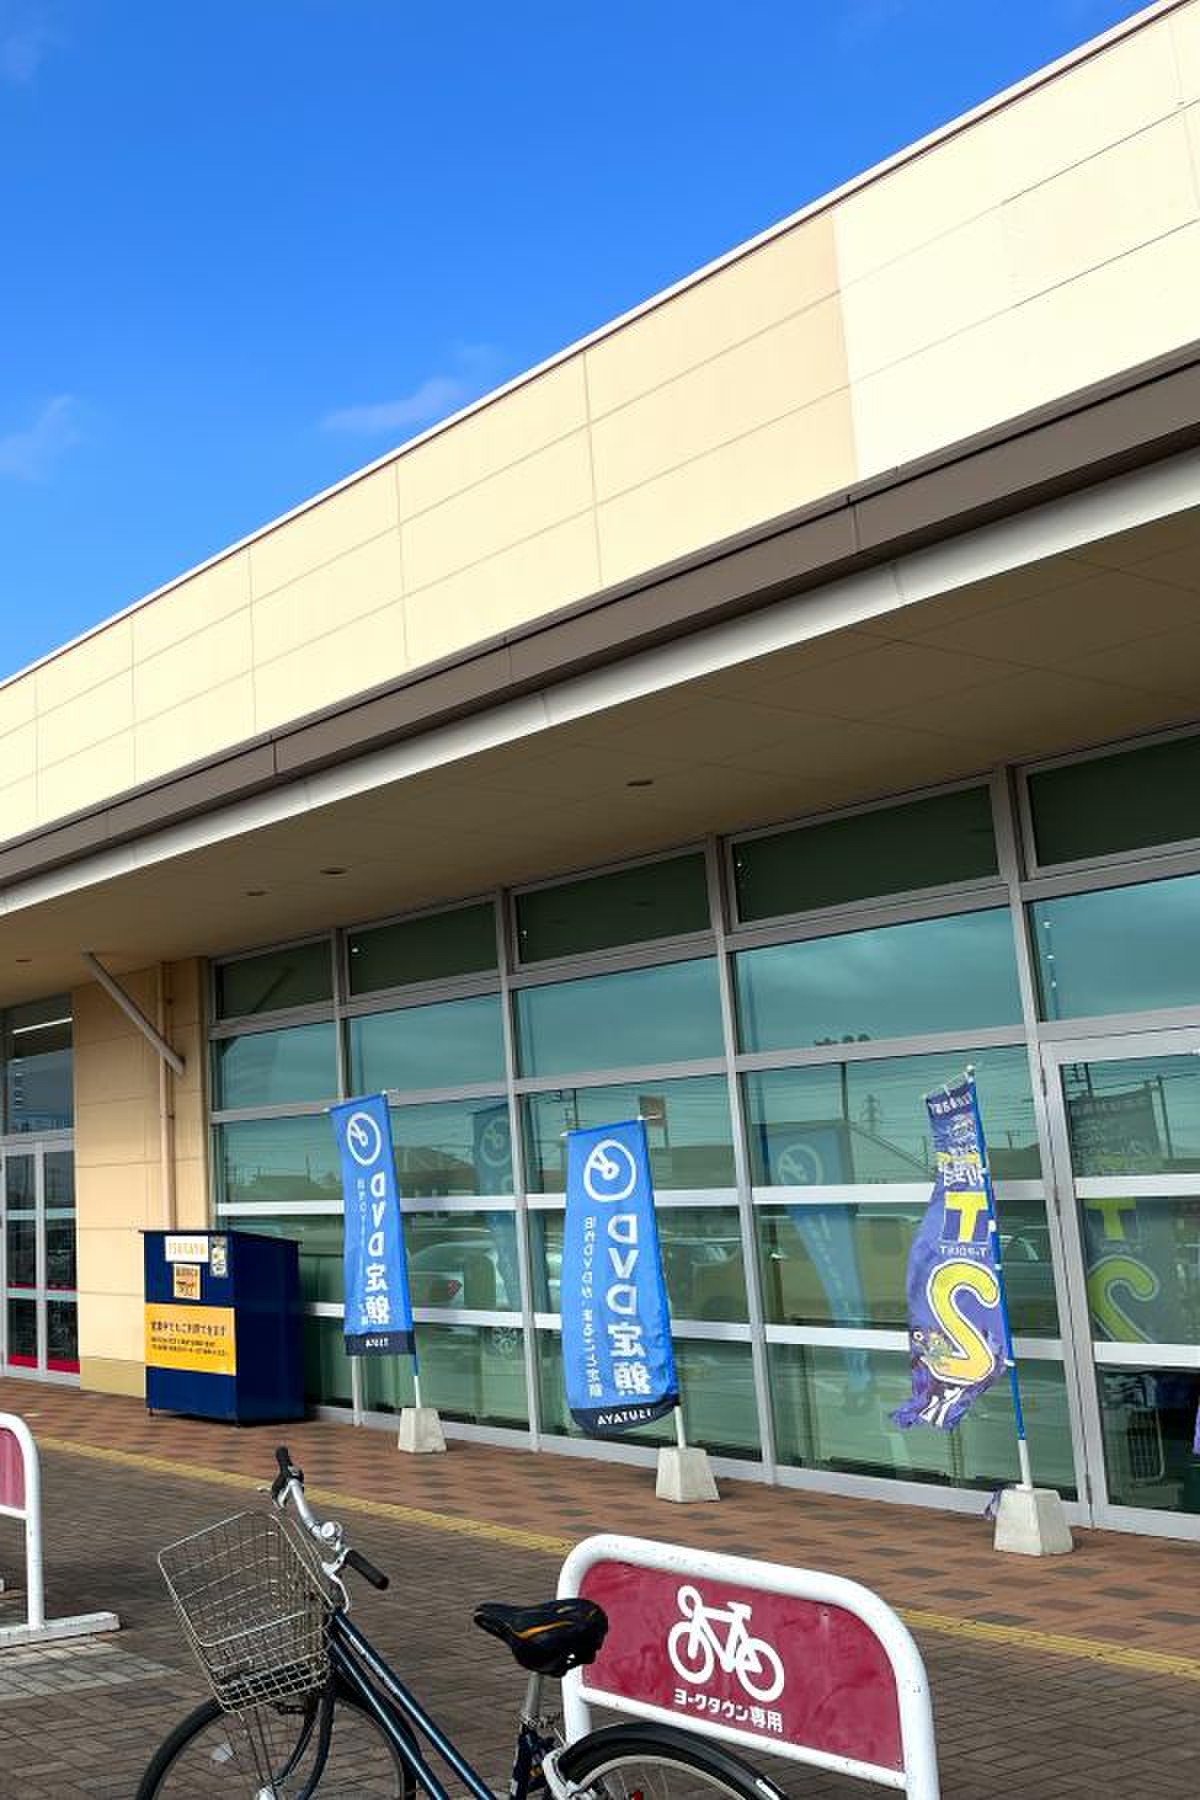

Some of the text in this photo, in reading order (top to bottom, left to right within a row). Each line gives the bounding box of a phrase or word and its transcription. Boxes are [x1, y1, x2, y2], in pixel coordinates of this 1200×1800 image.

[673, 1687, 783, 1733] ヨークタウン専用
